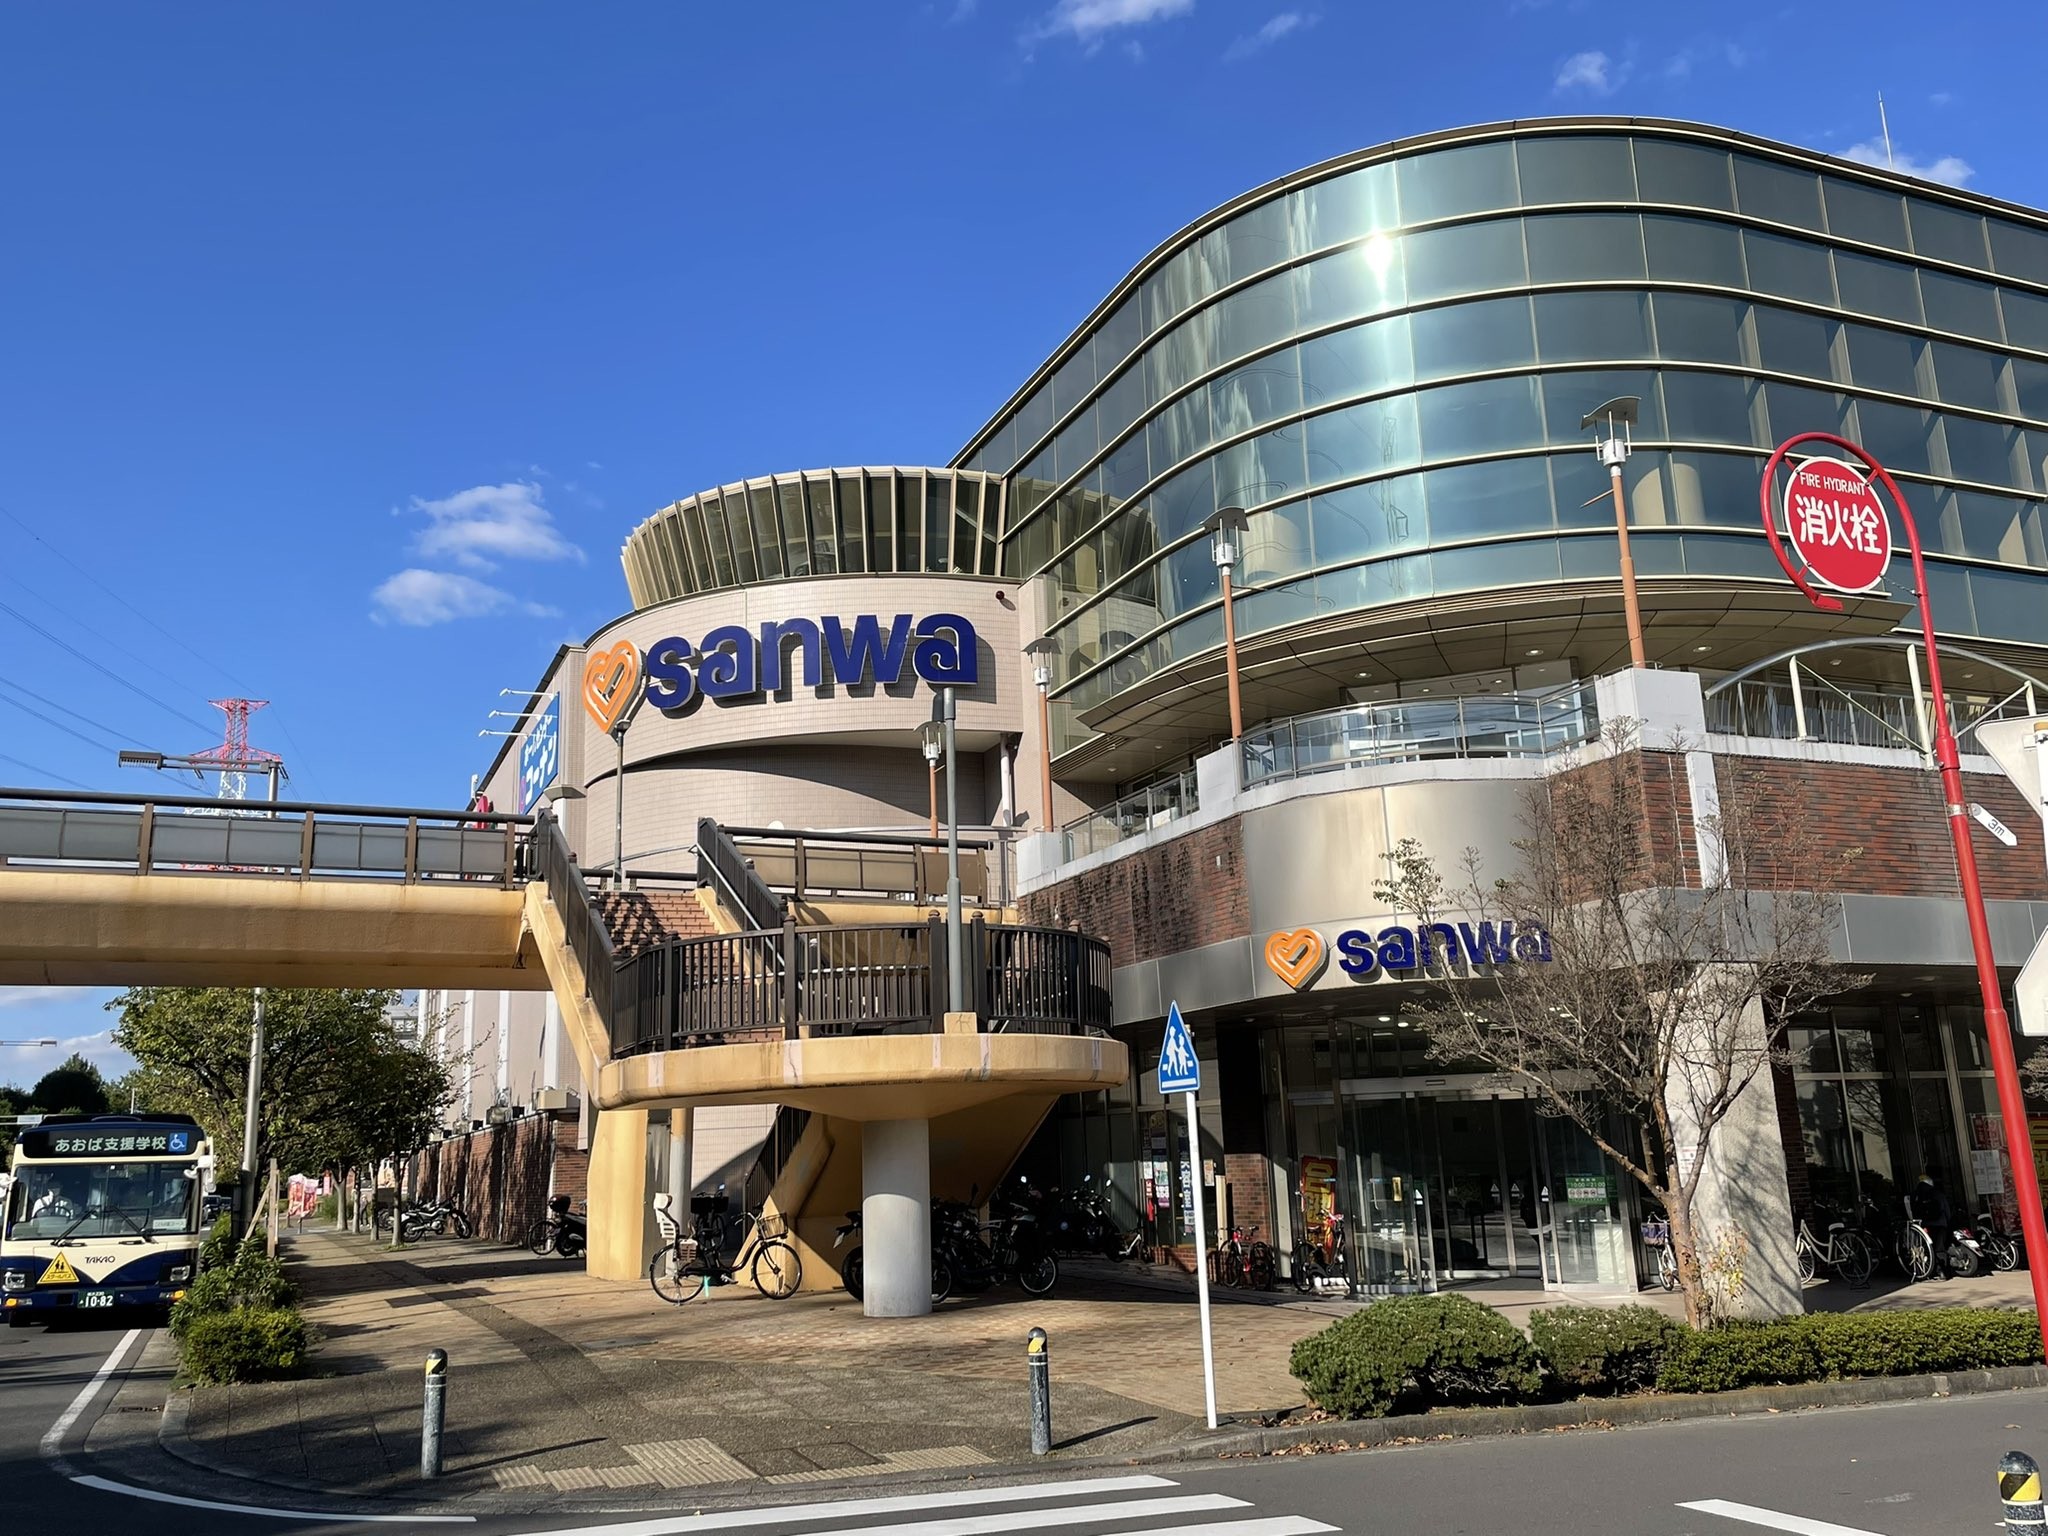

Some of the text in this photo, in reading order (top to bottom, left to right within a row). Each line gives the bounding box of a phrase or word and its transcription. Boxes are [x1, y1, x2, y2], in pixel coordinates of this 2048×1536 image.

[1800, 472, 1865, 496] FIRE HYDRANT
[1795, 493, 1882, 555] 消火栓
[645, 613, 978, 710] sanwa
[1987, 818, 2005, 836] 3m
[1336, 919, 1552, 975] sanwa
[55, 1136, 166, 1152] あおば支援学校
[85, 1256, 115, 1264] TAKAO
